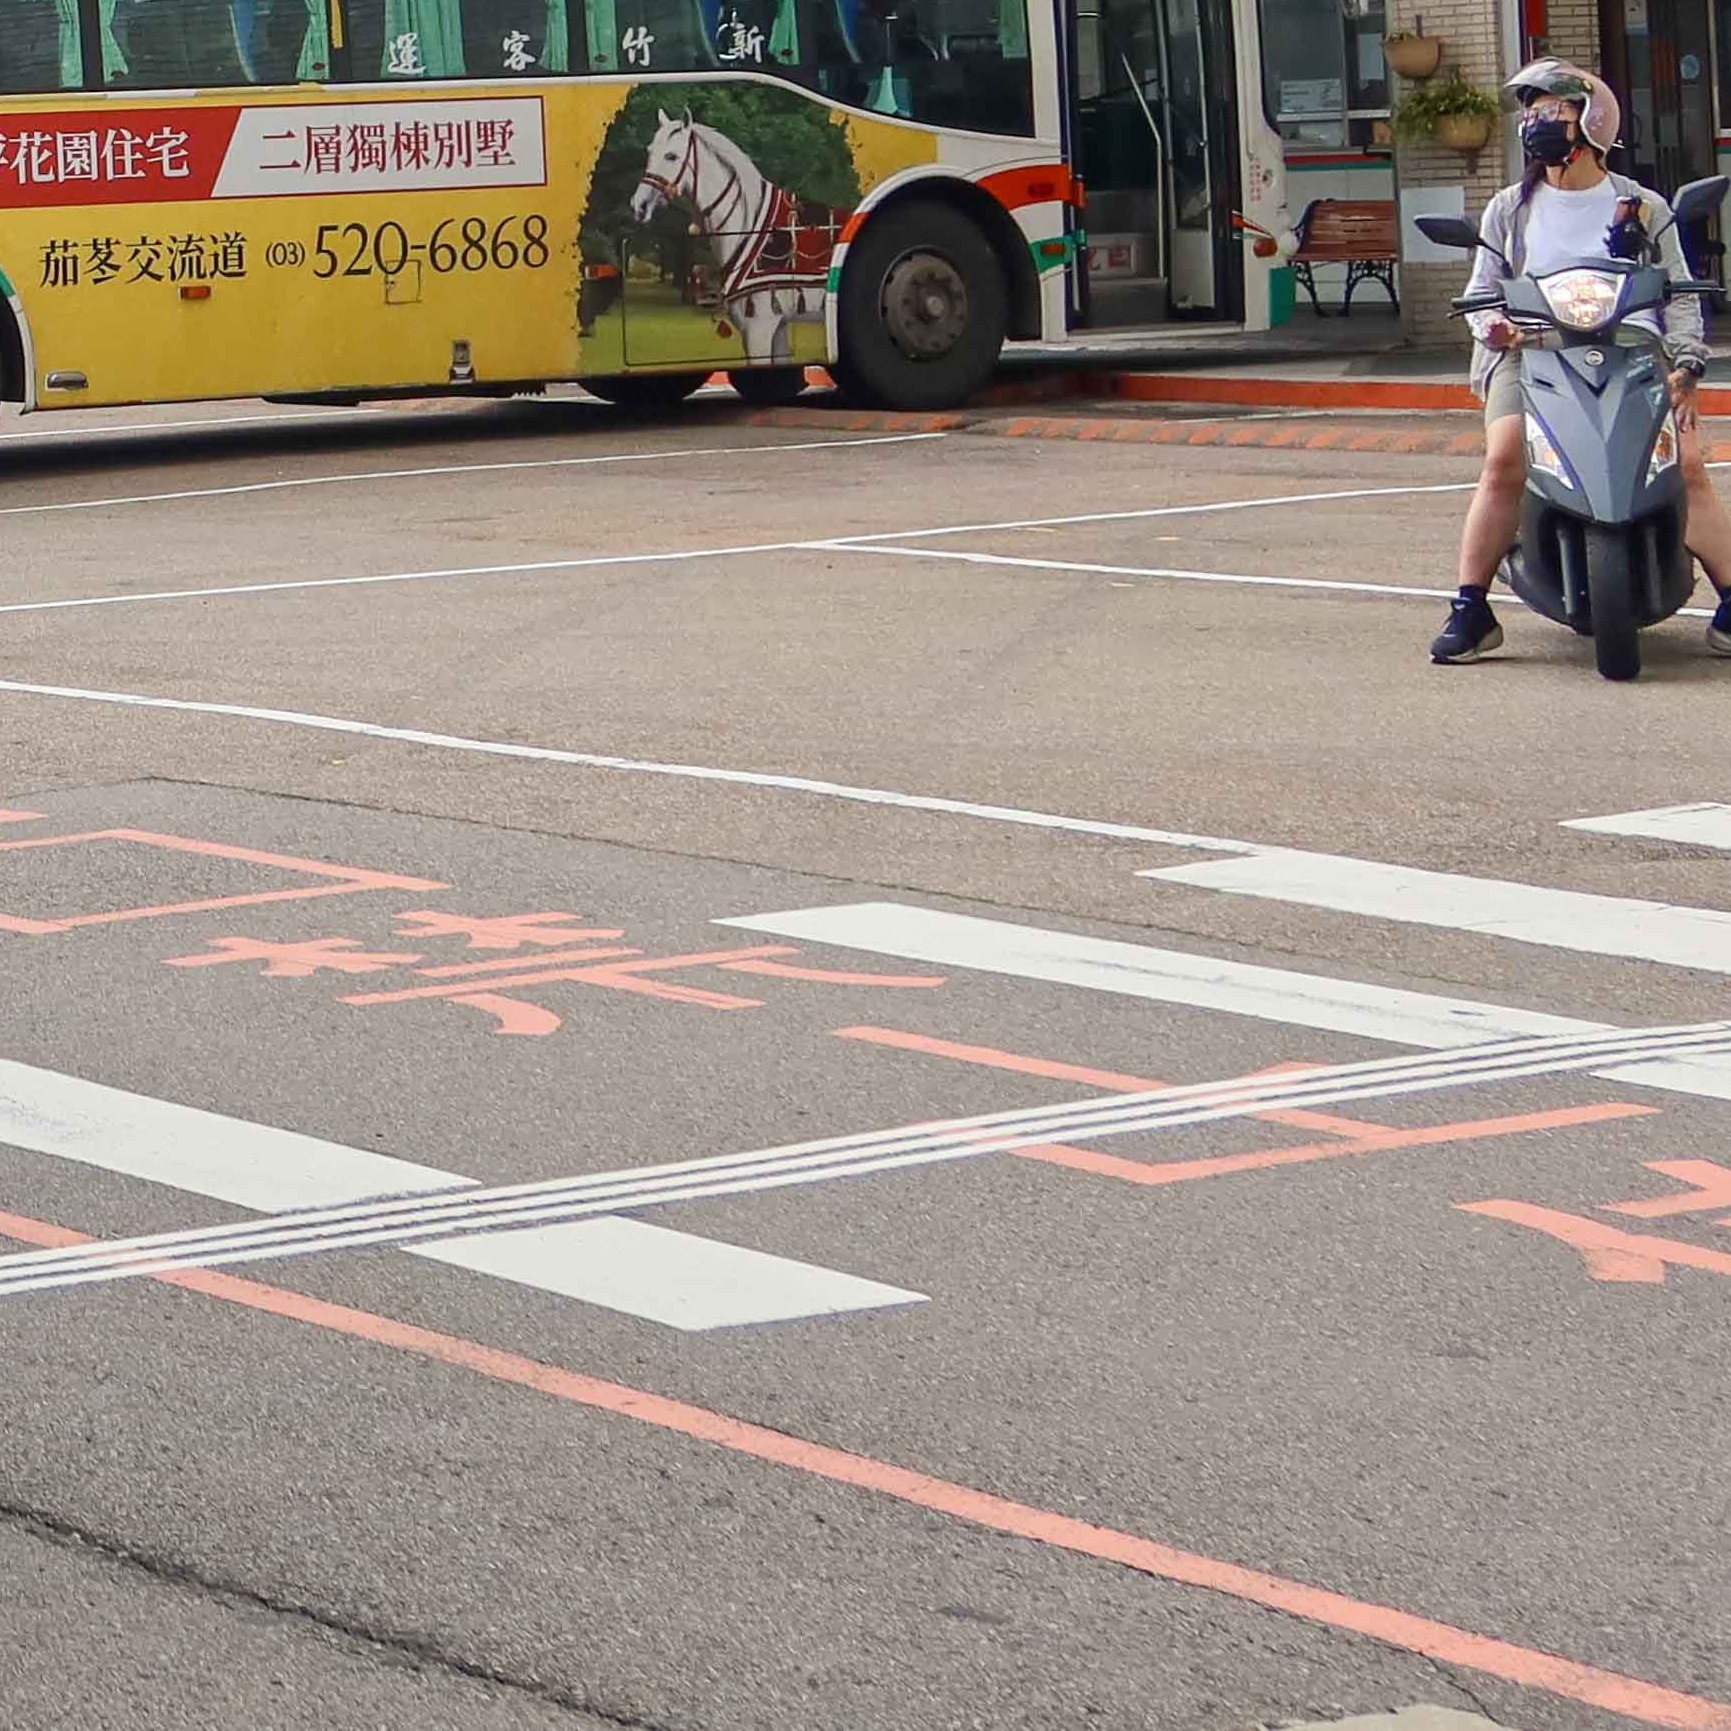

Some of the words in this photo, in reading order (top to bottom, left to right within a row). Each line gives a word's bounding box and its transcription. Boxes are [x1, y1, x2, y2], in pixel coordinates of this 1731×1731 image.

[258, 119, 516, 175] 二層獨棟別墅
[38, 230, 249, 288] 茄苳交流道
[264, 238, 307, 270] (03)
[313, 213, 550, 279] 520-6868
